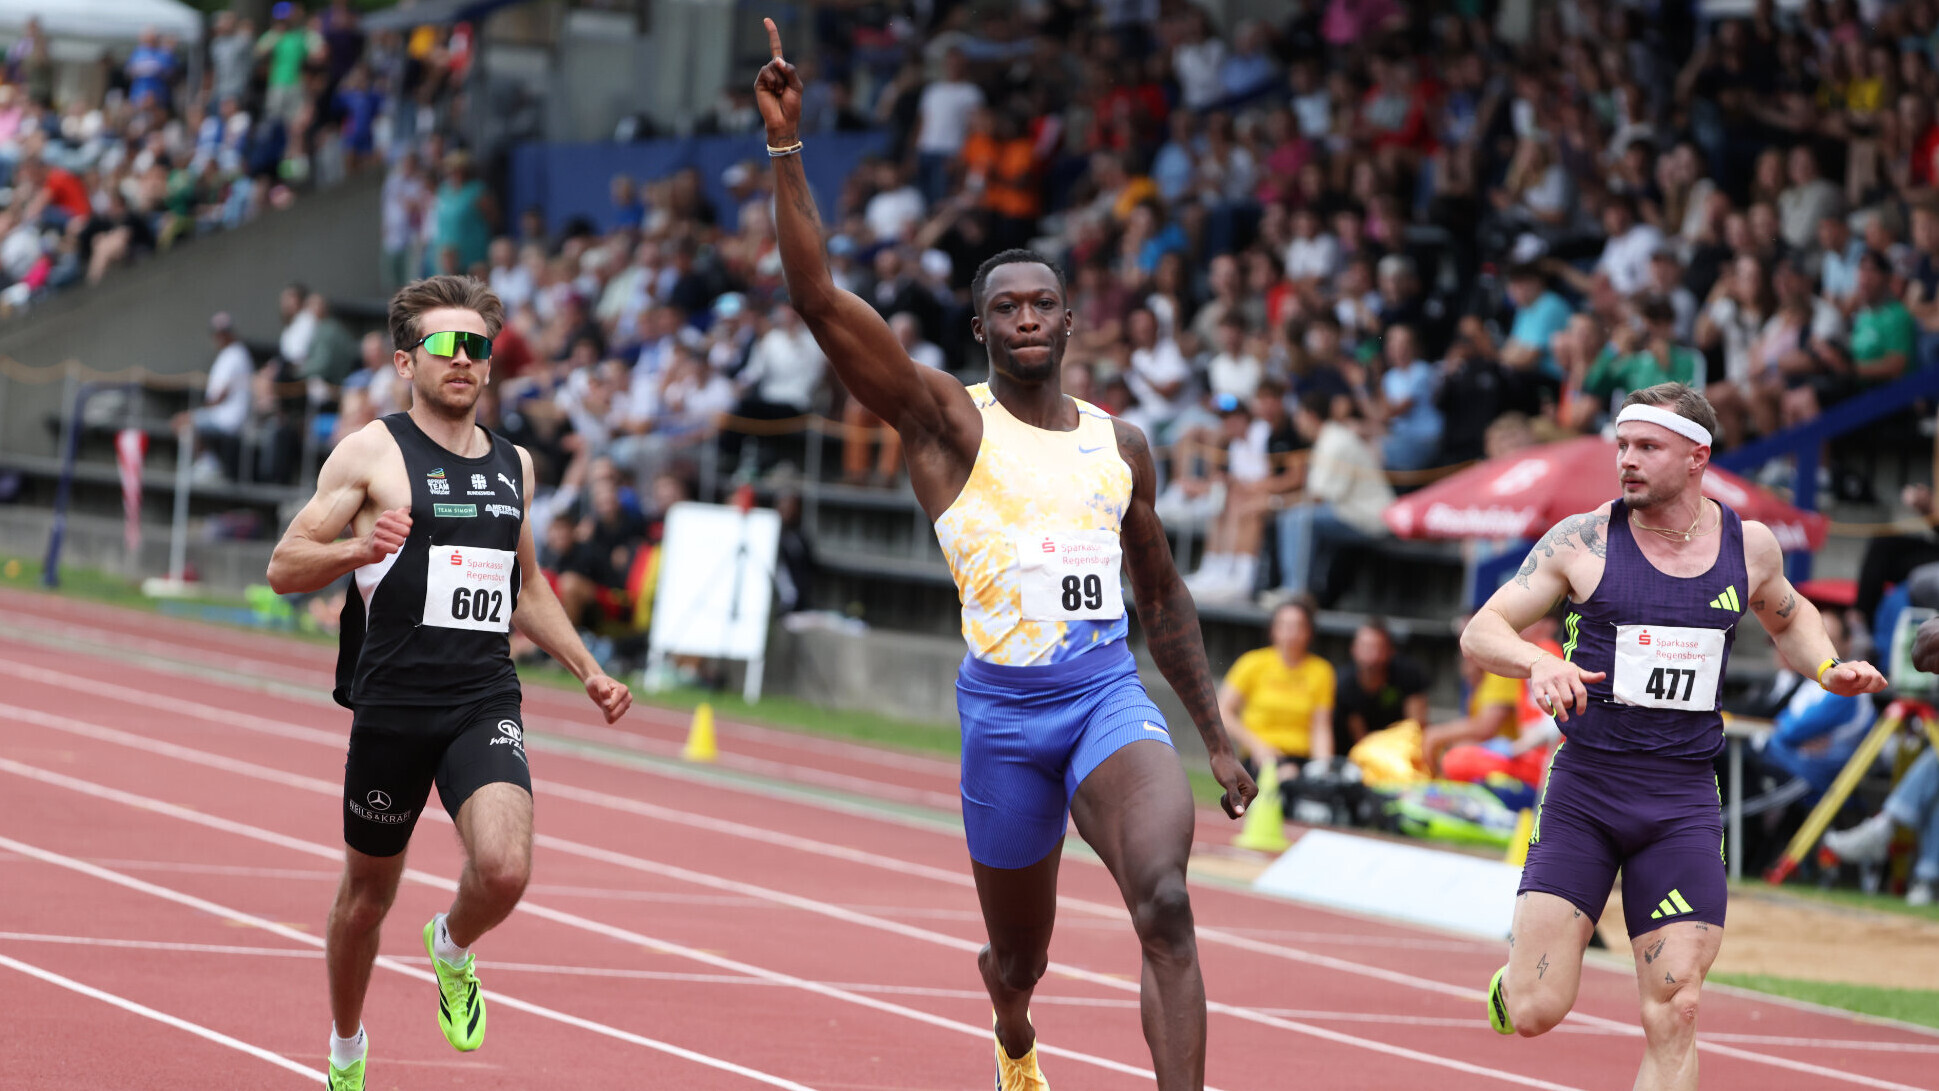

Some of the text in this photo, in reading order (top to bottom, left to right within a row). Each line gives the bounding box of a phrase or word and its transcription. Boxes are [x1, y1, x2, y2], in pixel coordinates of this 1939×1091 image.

[430, 483, 450, 491] TEAM
[1062, 574, 1102, 611] 89
[452, 587, 502, 622] 602
[1656, 638, 1699, 649] Sparkasse
[1656, 650, 1706, 662] Regensburg
[1646, 667, 1696, 701] 477
